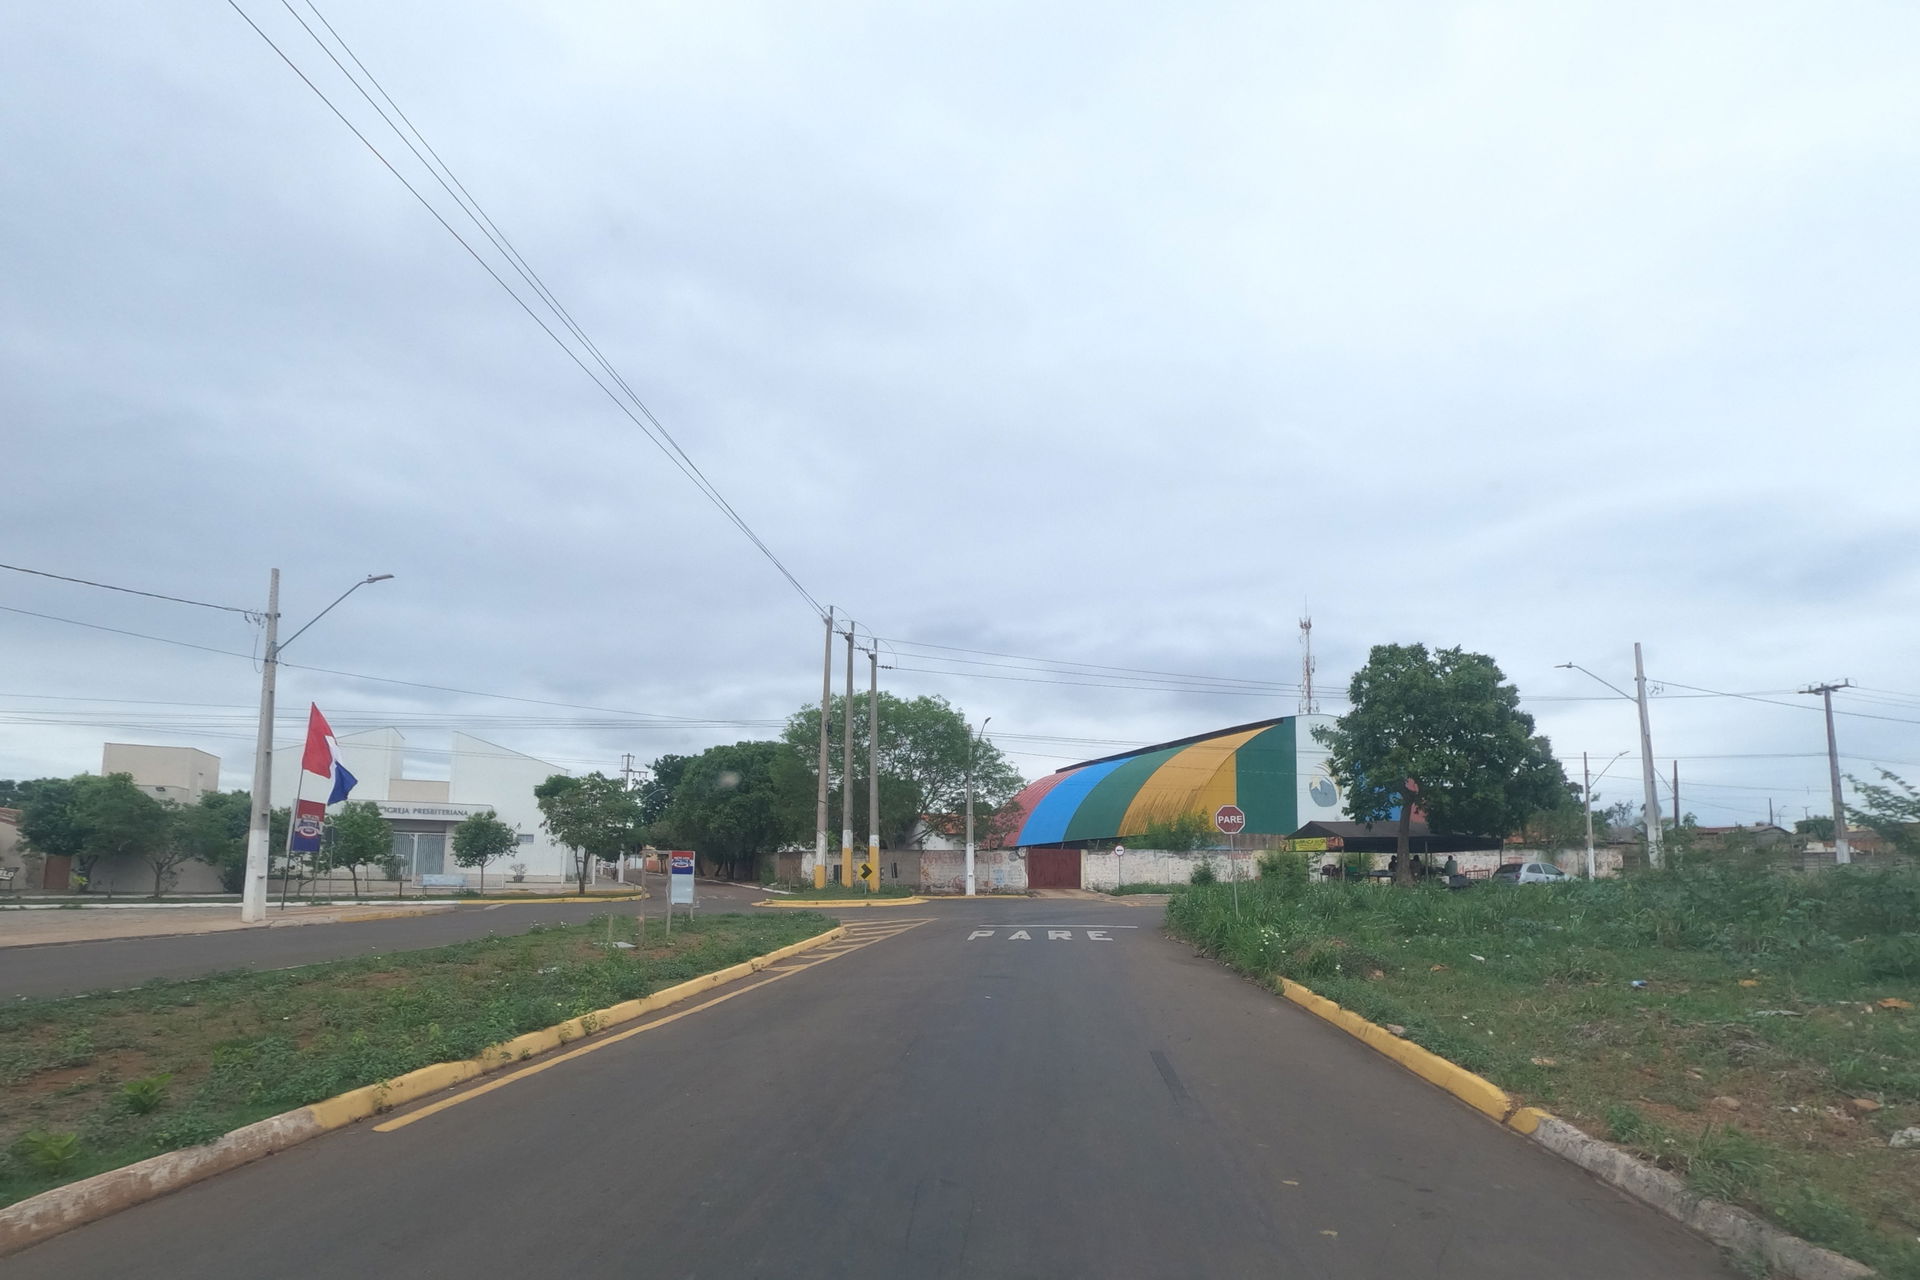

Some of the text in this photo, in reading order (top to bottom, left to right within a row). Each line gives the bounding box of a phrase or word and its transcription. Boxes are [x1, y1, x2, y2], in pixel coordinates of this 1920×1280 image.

[385, 806, 469, 816] IGREJA PRESBITERIANA
[1218, 816, 1243, 824] PARE
[967, 930, 1114, 941] PARE
